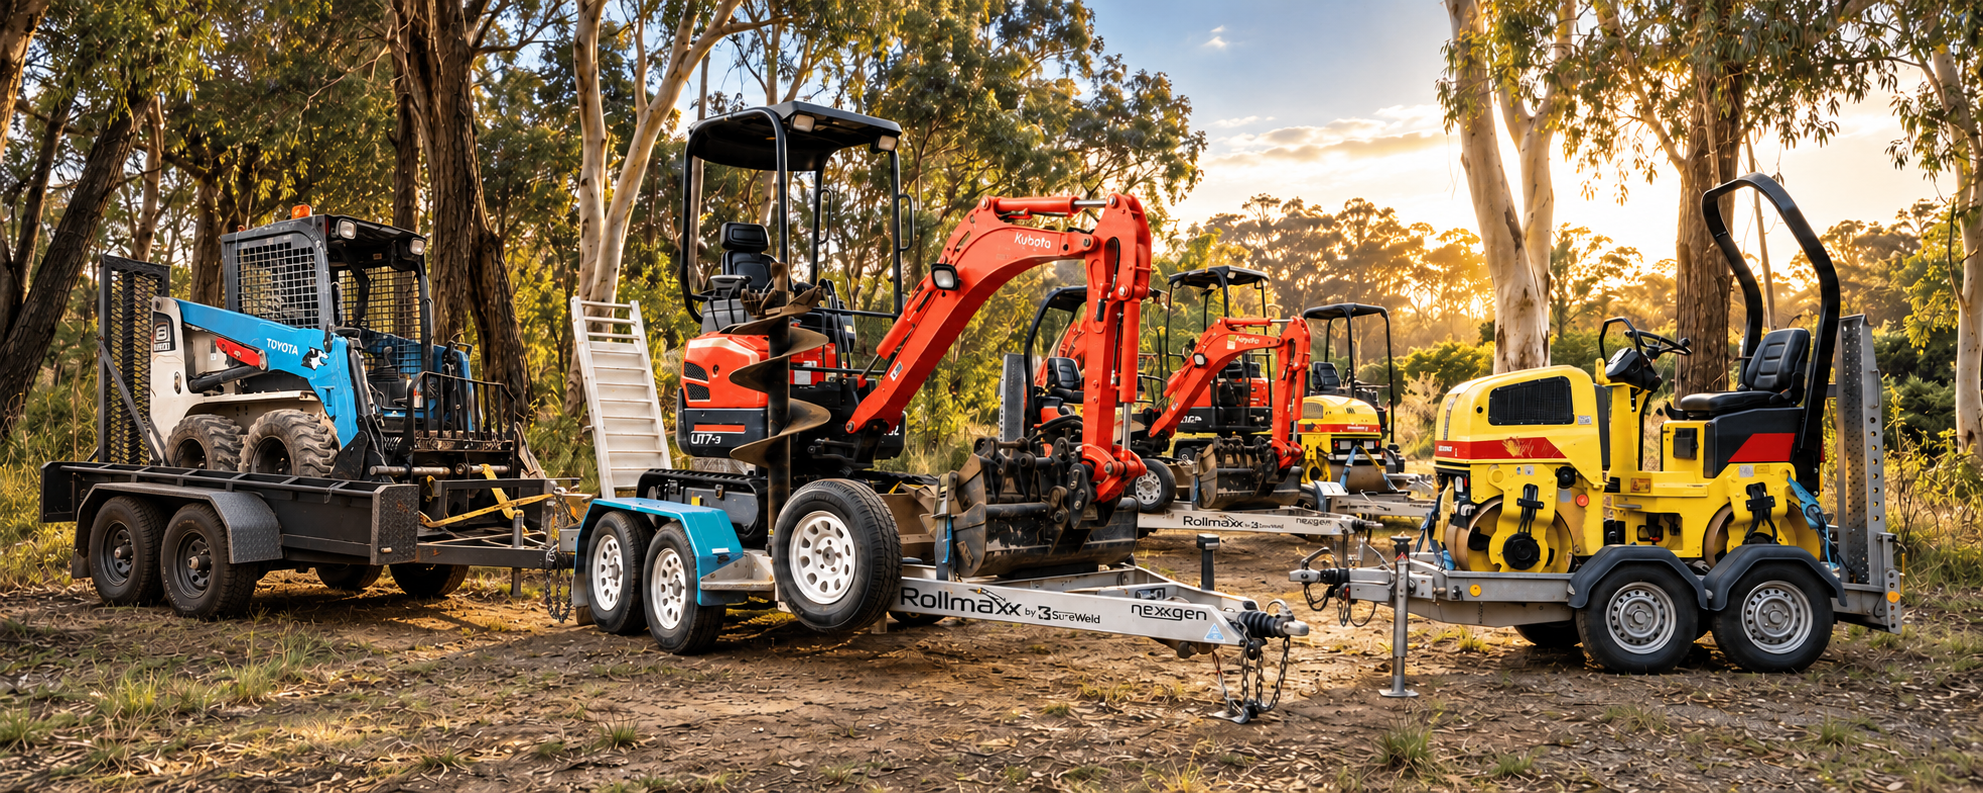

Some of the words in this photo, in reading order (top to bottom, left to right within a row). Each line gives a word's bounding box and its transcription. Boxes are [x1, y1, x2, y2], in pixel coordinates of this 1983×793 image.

[266, 338, 299, 356] TOYOTA
[1183, 515, 1243, 528] Rollmaxx
[900, 587, 1022, 617] Rollmaxx
[1025, 607, 1037, 618] by
[1052, 611, 1101, 624] SureWeld
[1131, 604, 1207, 621] nexxgen
